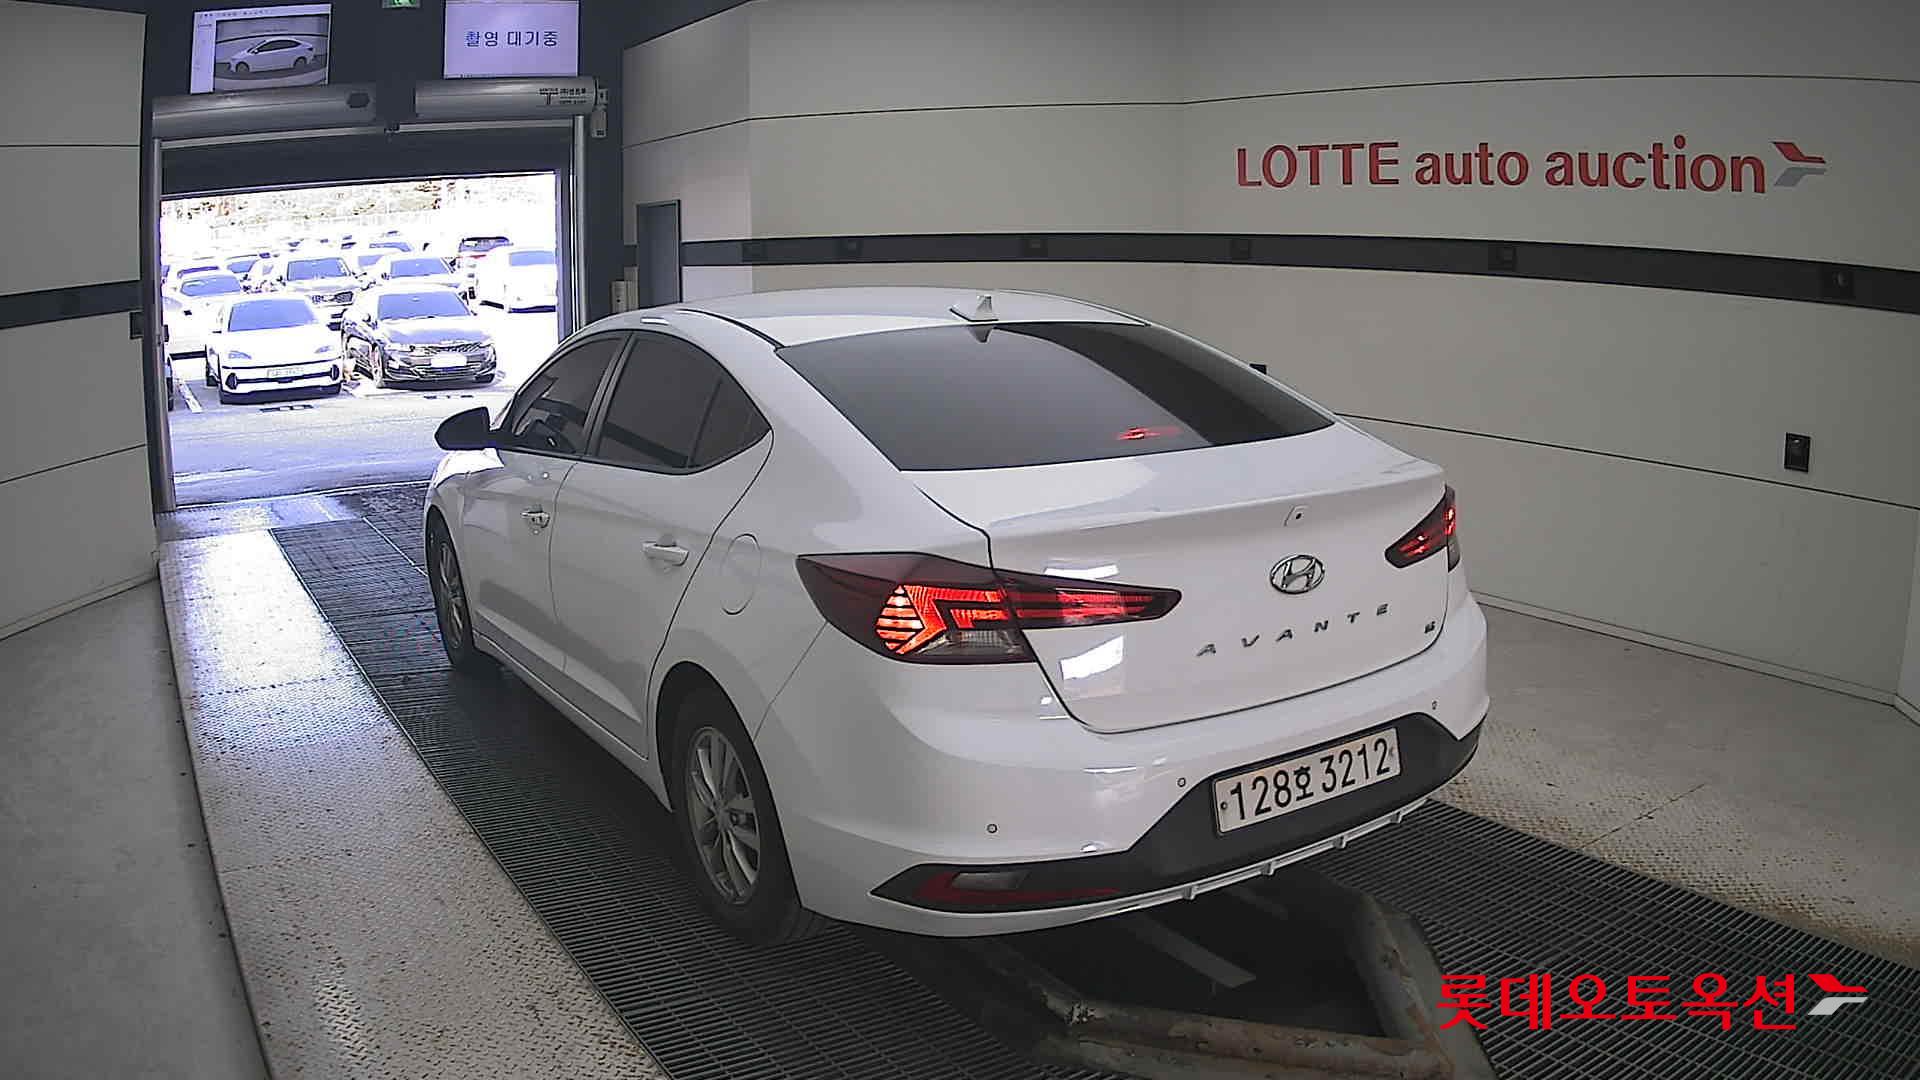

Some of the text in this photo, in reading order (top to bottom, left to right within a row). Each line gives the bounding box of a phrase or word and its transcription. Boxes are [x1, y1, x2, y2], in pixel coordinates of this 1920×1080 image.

[507, 31, 557, 47] 대기중
[1237, 134, 1766, 194] LOTTE auto auction
[1197, 603, 1389, 657] AVANTE
